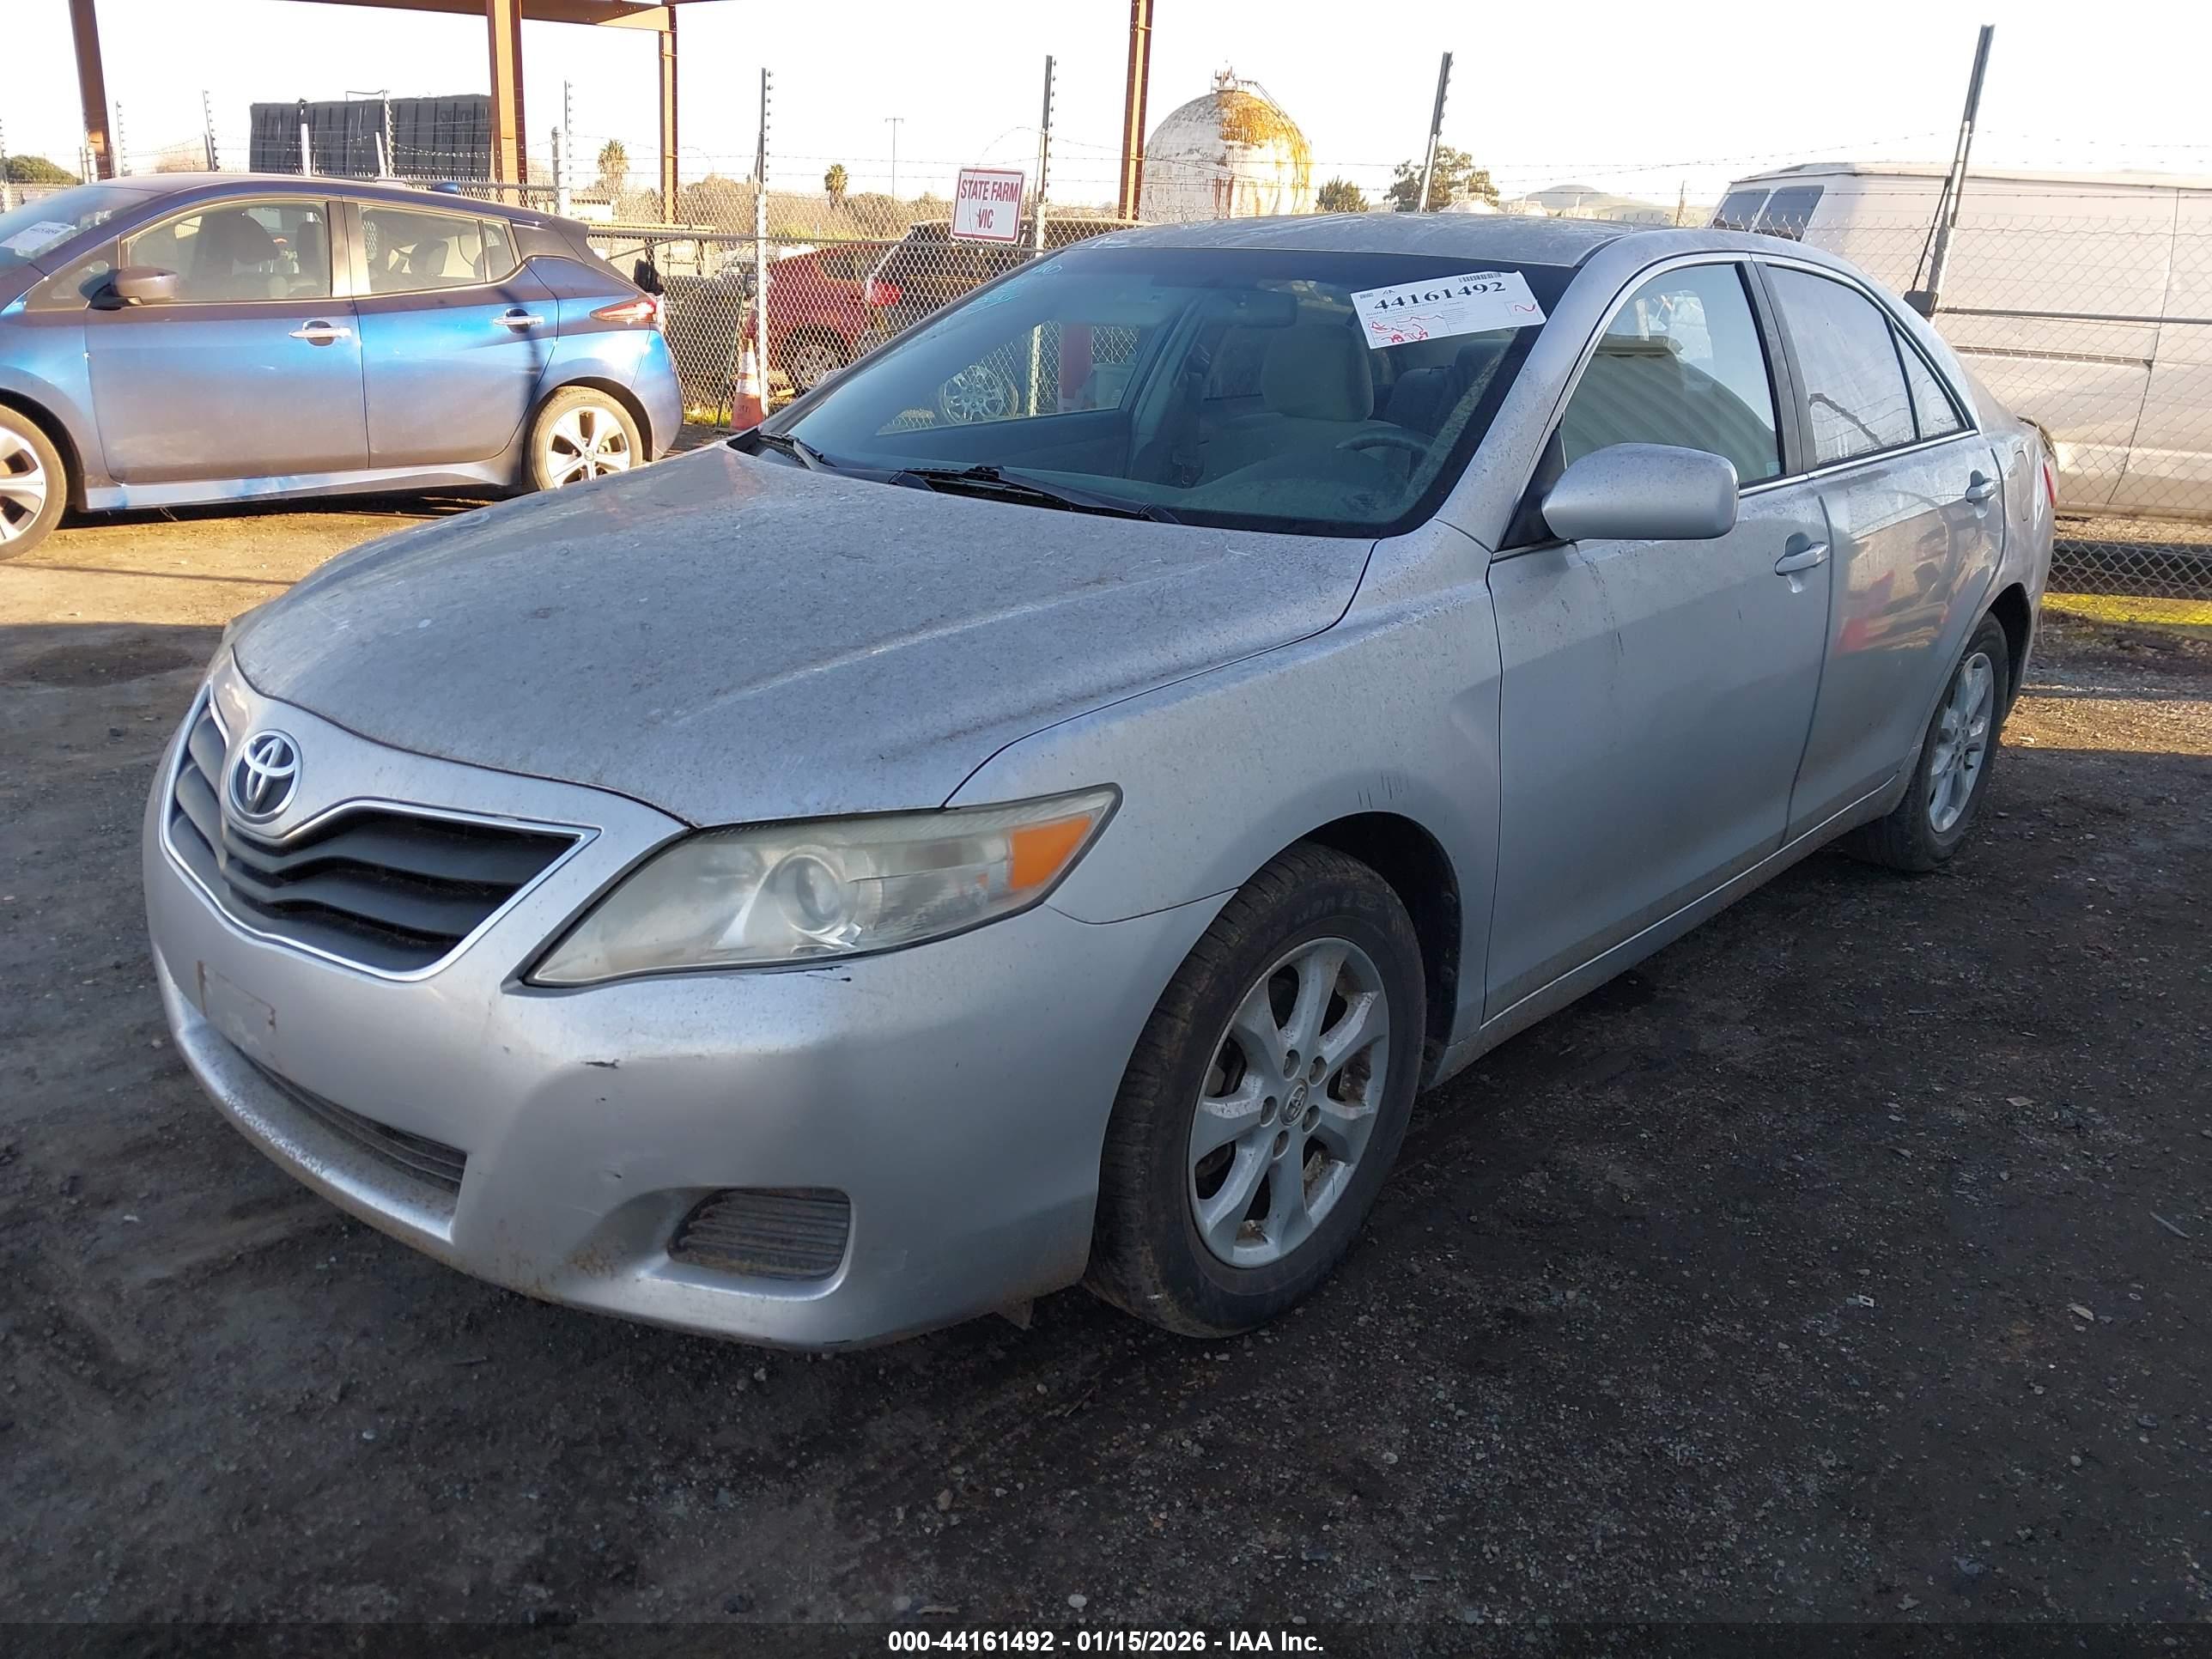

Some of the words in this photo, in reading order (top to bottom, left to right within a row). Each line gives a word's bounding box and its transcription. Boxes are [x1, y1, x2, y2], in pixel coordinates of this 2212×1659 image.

[961, 179, 990, 200] STATE
[990, 181, 1018, 203] FARM
[978, 209, 994, 228] VIC
[1374, 281, 1506, 310] 44161492
